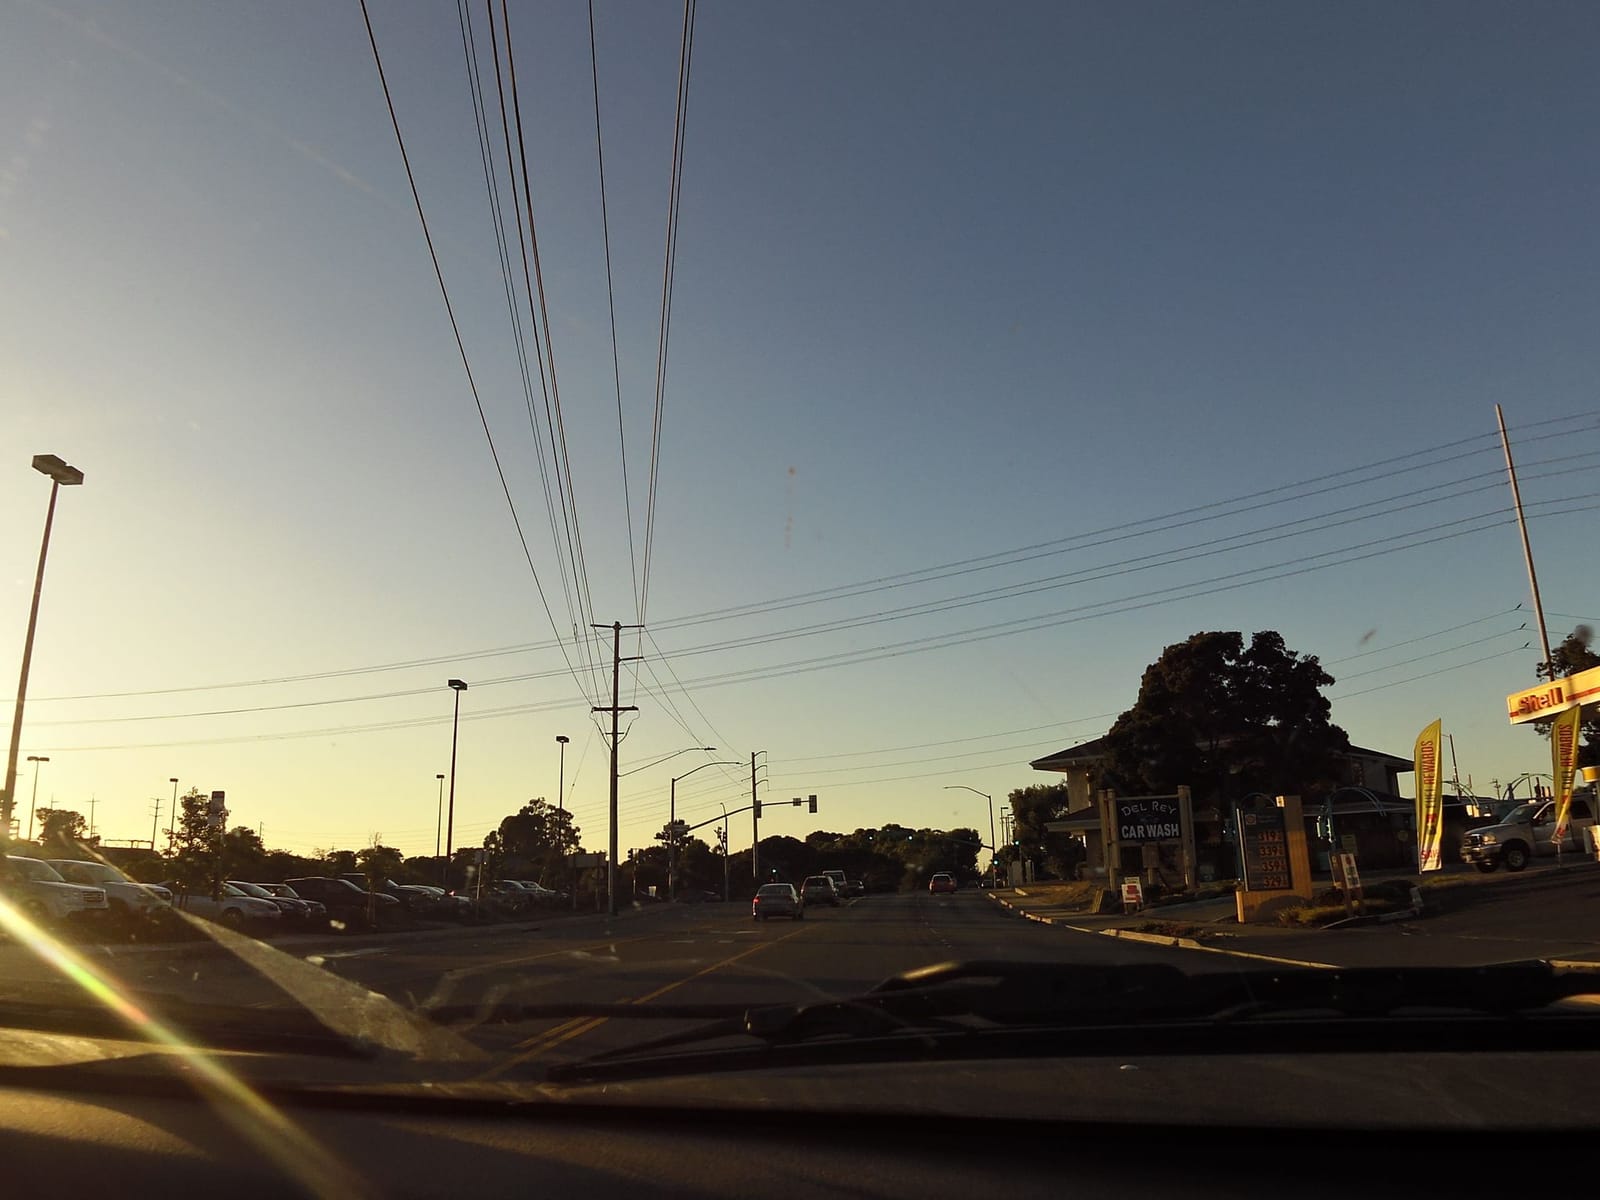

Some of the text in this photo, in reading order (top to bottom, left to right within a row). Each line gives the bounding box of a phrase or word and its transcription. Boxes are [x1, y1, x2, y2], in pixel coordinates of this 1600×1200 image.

[1519, 687, 1564, 714] Shell
[1558, 724, 1573, 767] REWARDS
[1421, 740, 1435, 785] REWARDS
[1121, 801, 1177, 816] DEL REY
[1121, 823, 1179, 839] CAR WASH
